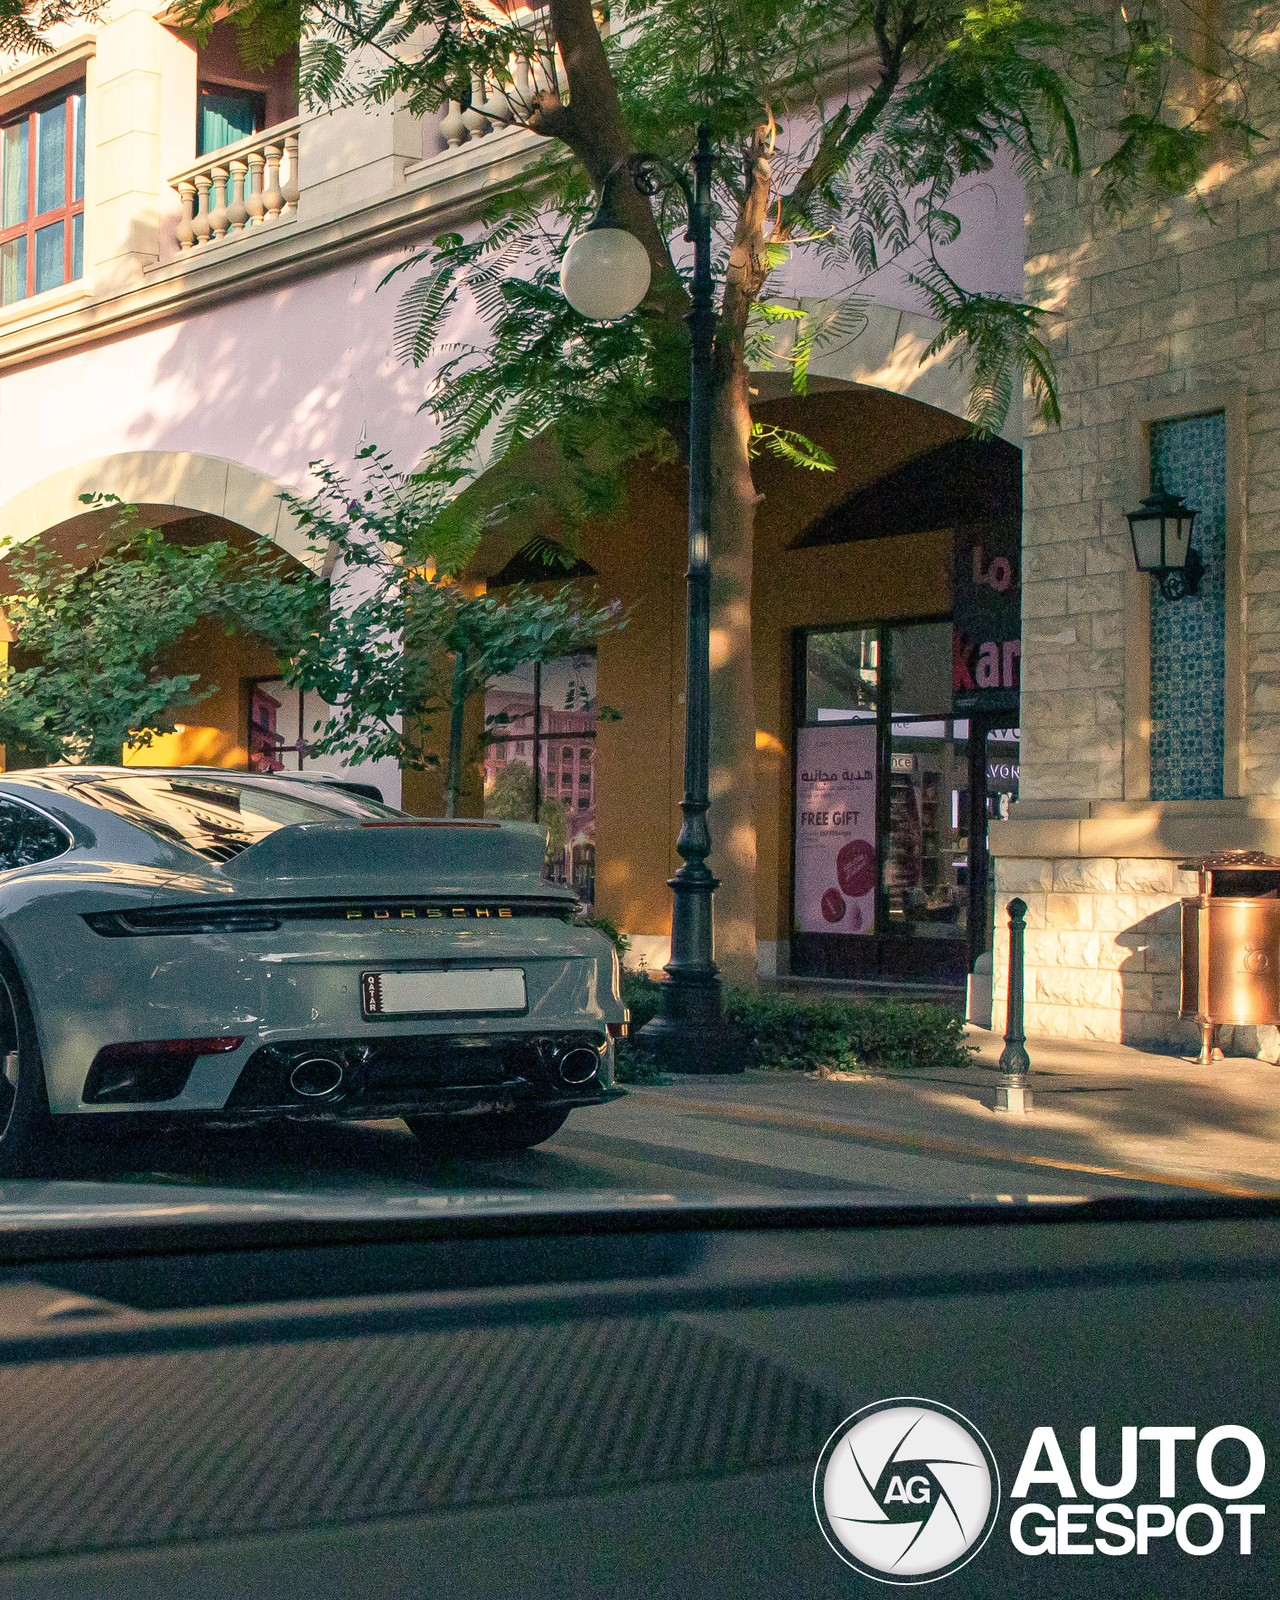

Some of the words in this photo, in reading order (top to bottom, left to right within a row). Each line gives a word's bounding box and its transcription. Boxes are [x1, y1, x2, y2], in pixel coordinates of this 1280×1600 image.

[801, 811, 829, 826] FREE
[833, 811, 860, 826] GIFT
[346, 908, 513, 919] PORSCHE
[367, 976, 377, 1012] QATAR
